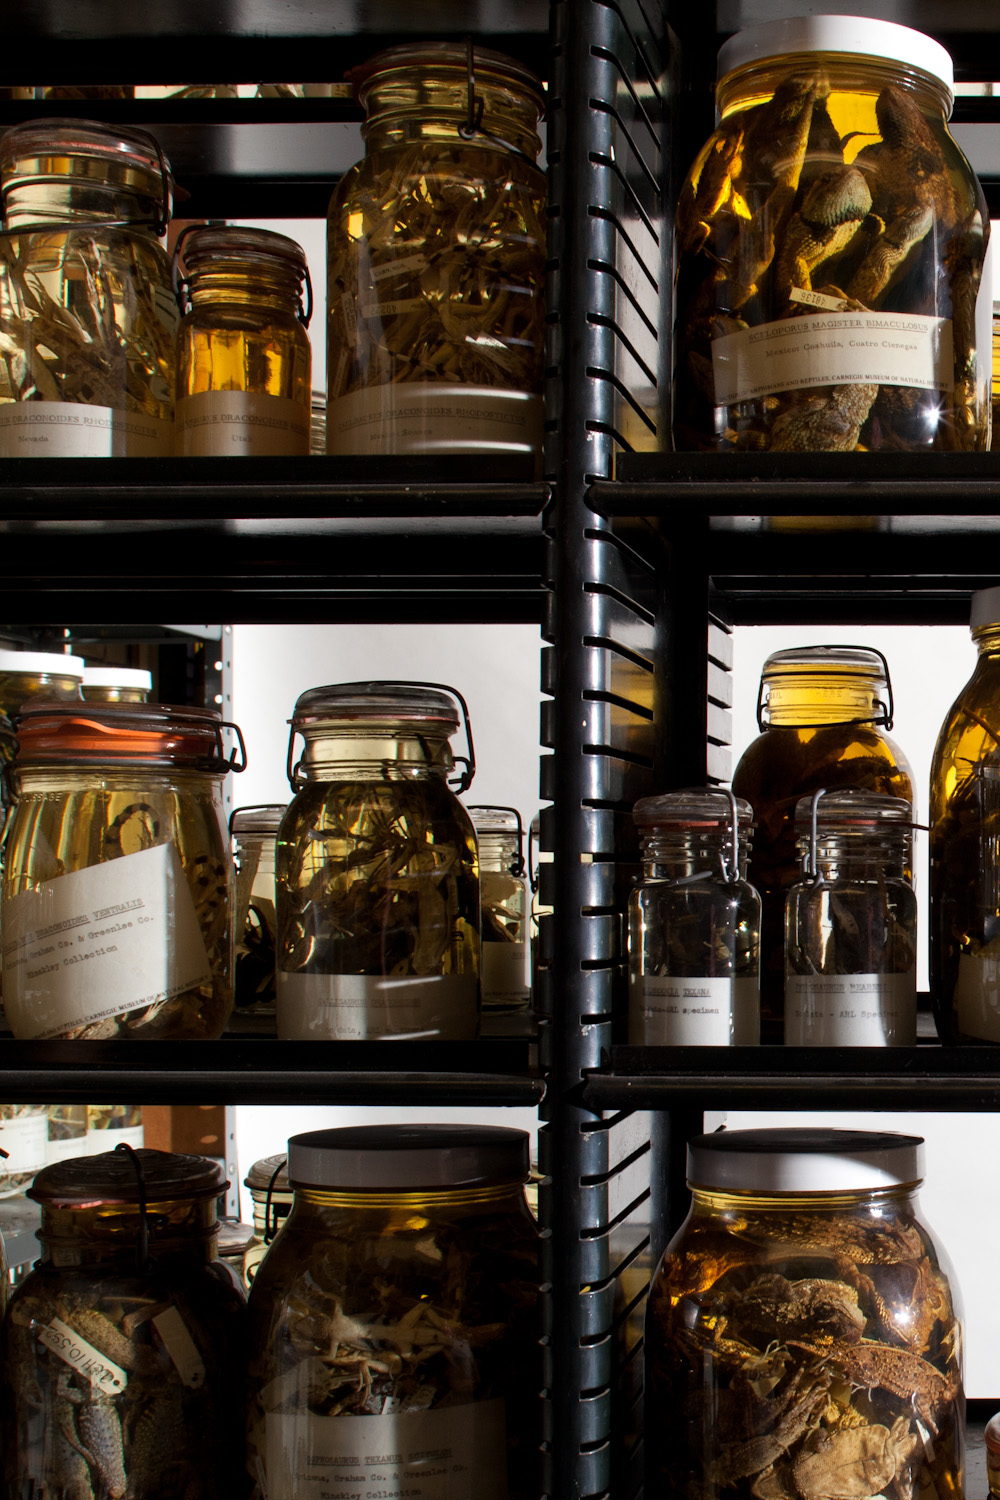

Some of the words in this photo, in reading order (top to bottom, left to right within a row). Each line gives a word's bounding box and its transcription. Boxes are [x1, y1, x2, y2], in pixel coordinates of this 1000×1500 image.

[748, 322, 809, 342] SCELOPORUS
[812, 320, 863, 330] MAGISTER
[866, 320, 928, 332] BIMACULOSUS
[765, 346, 799, 358] Mexico:
[803, 341, 844, 352] Coahuila,
[849, 339, 879, 348] Cuatro
[881, 341, 918, 351] Cienegas
[832, 374, 863, 382] CARNEGIE
[12, 414, 80, 423] DRACONOIDES
[18, 435, 48, 443] Nevada
[93, 899, 144, 921] VENTRALIS
[88, 921, 133, 940] Greenlee
[137, 914, 154, 925] Co.
[63, 944, 118, 966] Collection
[839, 1010, 856, 1019] ARL
[364, 1455, 403, 1464] TEXANUS
[334, 1473, 366, 1482] Graham
[371, 1472, 386, 1481] Co.
[366, 1489, 421, 1498] Collection
